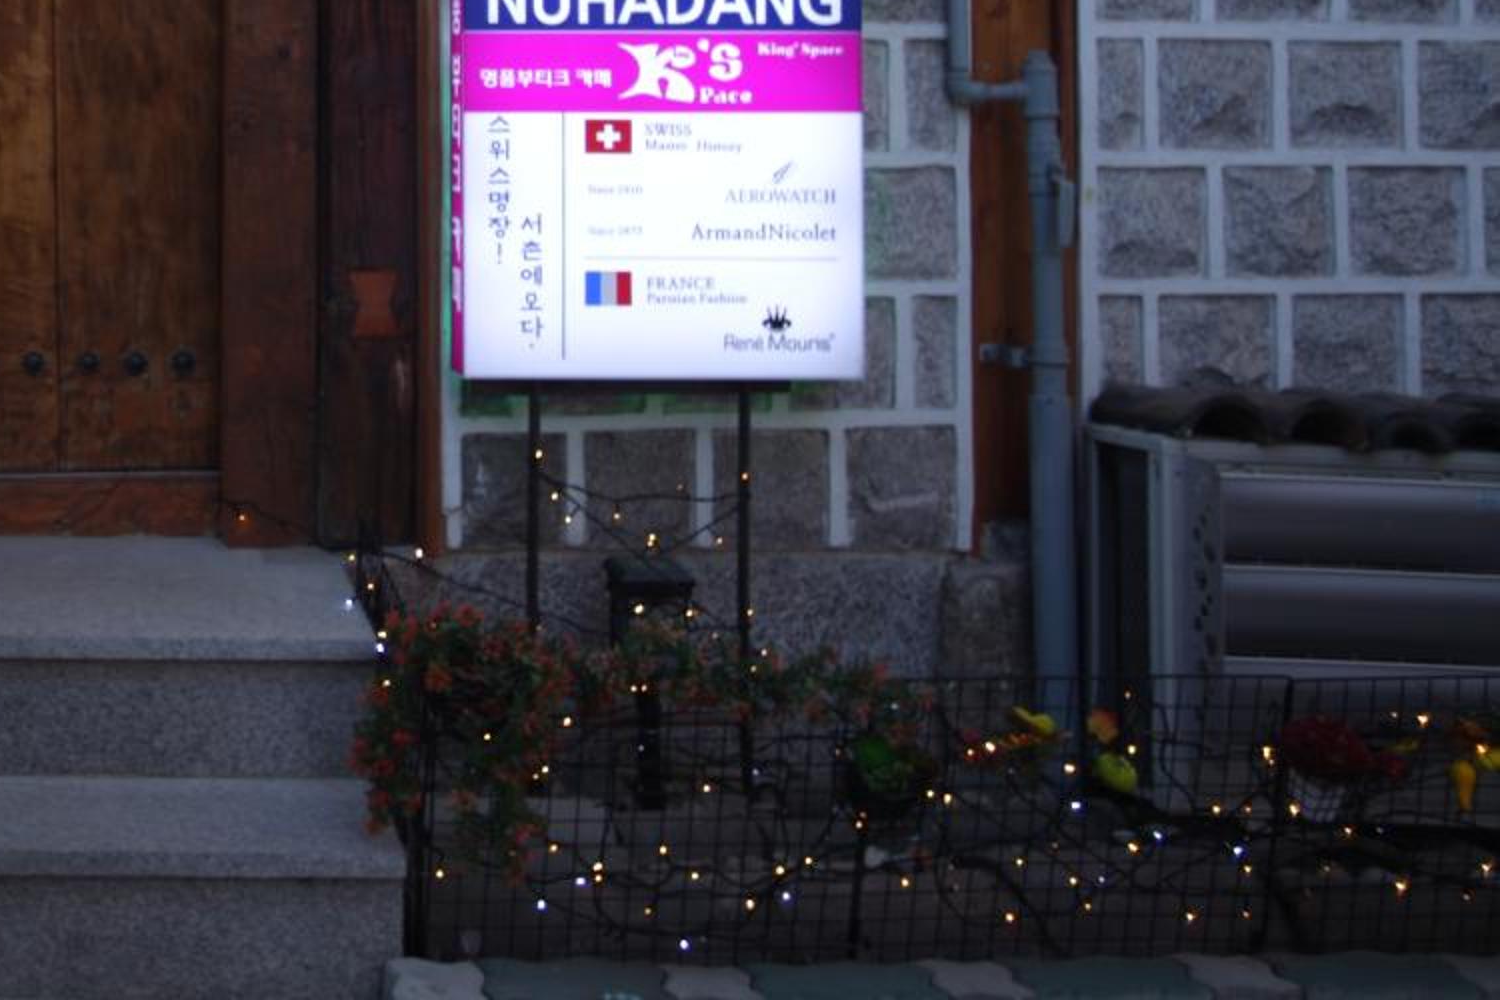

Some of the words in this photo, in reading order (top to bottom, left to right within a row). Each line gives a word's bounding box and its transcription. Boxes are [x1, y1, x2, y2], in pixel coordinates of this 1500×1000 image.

[643, 123, 692, 137] SWISS
[725, 188, 836, 204] AEROWATCH
[646, 276, 716, 290] FRANCE
